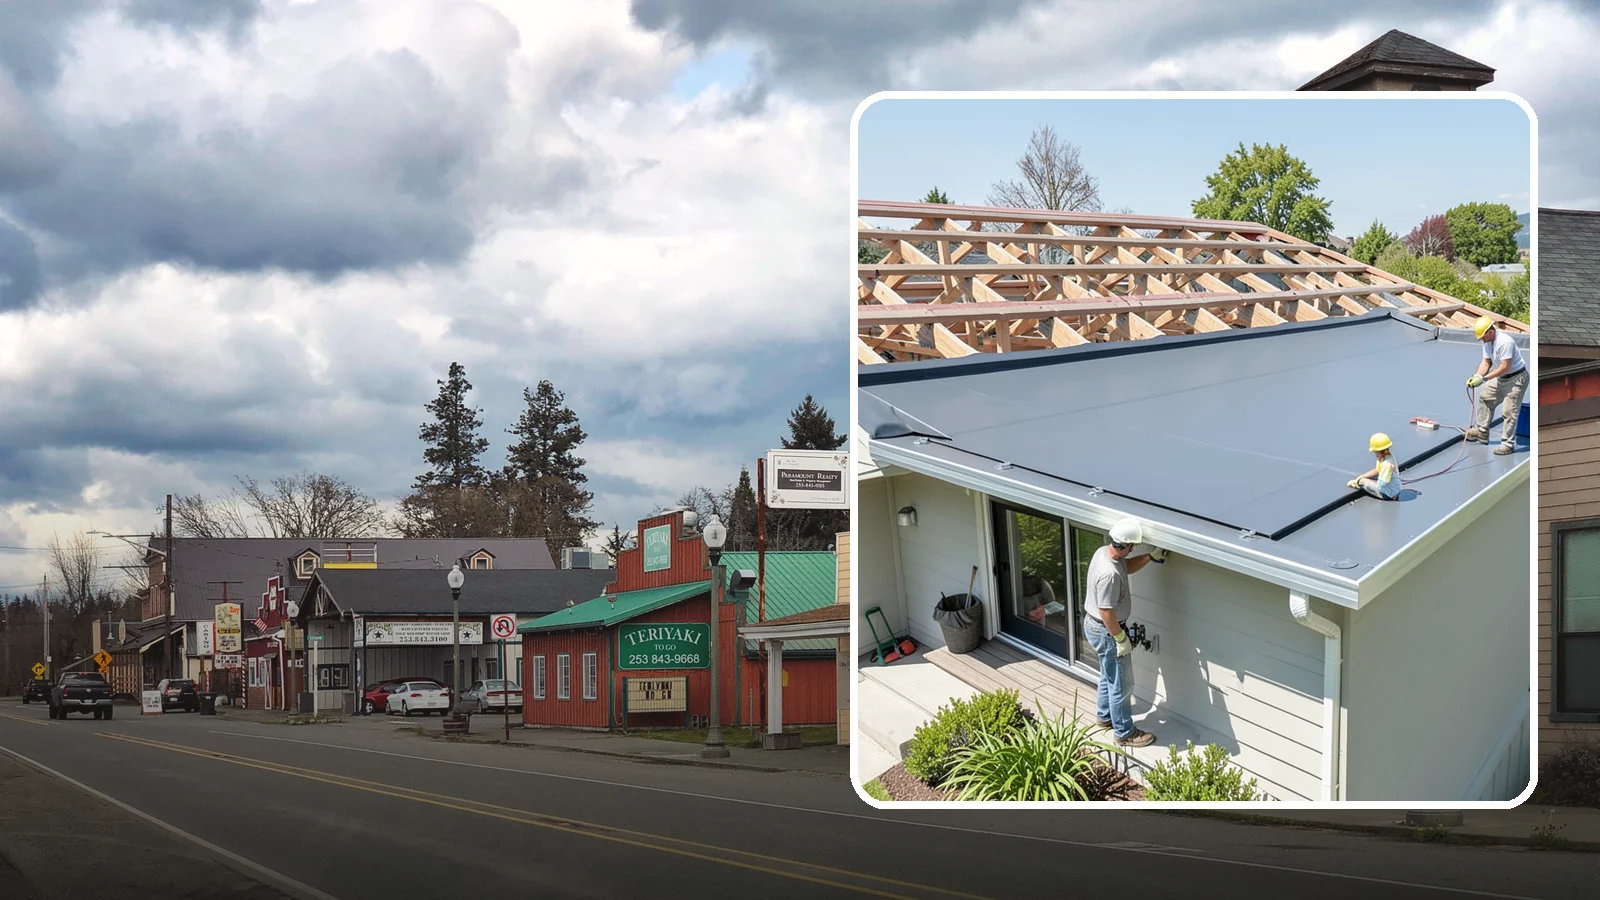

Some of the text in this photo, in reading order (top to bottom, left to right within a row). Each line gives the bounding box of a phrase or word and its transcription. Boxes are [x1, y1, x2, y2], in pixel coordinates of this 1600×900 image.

[625, 627, 702, 646] TERIYAKI
[629, 654, 700, 664] 253 843-9668
[639, 681, 673, 691] TERIYAKI
